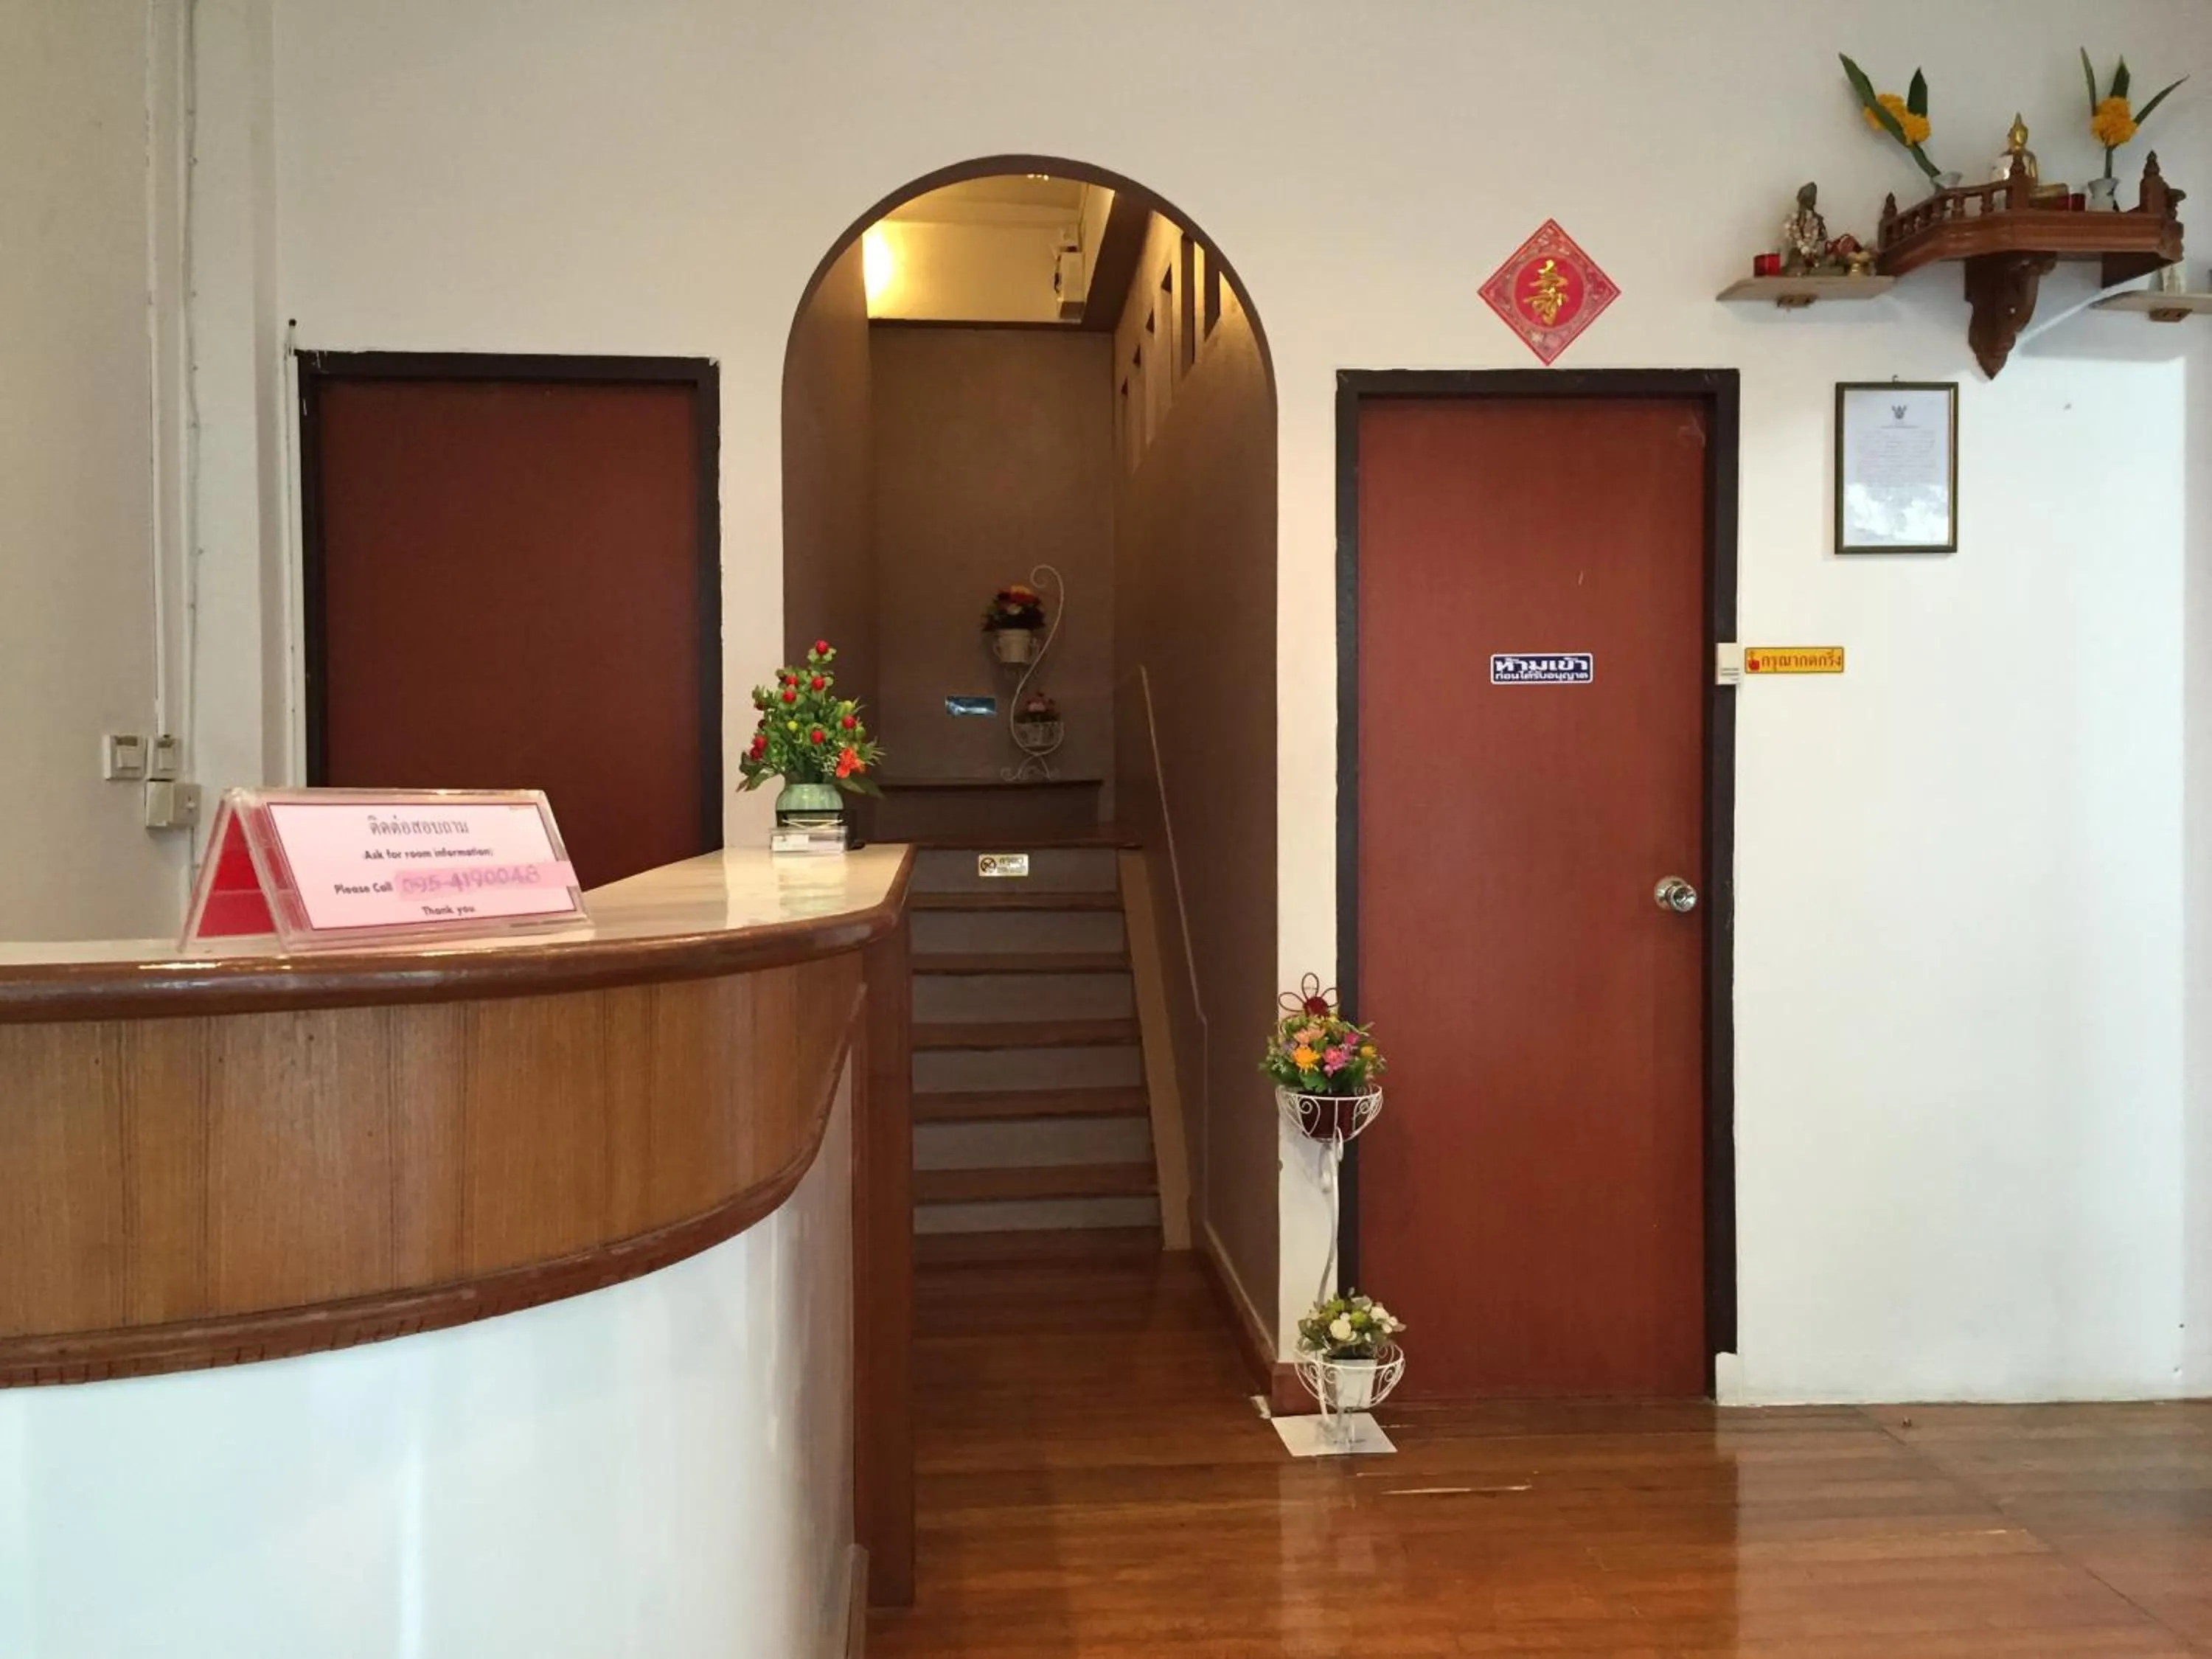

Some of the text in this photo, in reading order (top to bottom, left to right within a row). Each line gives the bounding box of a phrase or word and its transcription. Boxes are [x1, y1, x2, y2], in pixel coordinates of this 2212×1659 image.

[1495, 657, 1588, 672] ห้ามเข้า
[367, 815, 469, 835] ติดต่อสอบถาม
[365, 849, 384, 859] Ask
[386, 848, 402, 859] for
[405, 849, 432, 858] room
[334, 881, 393, 894] Please Call
[422, 906, 476, 916] Thank you
